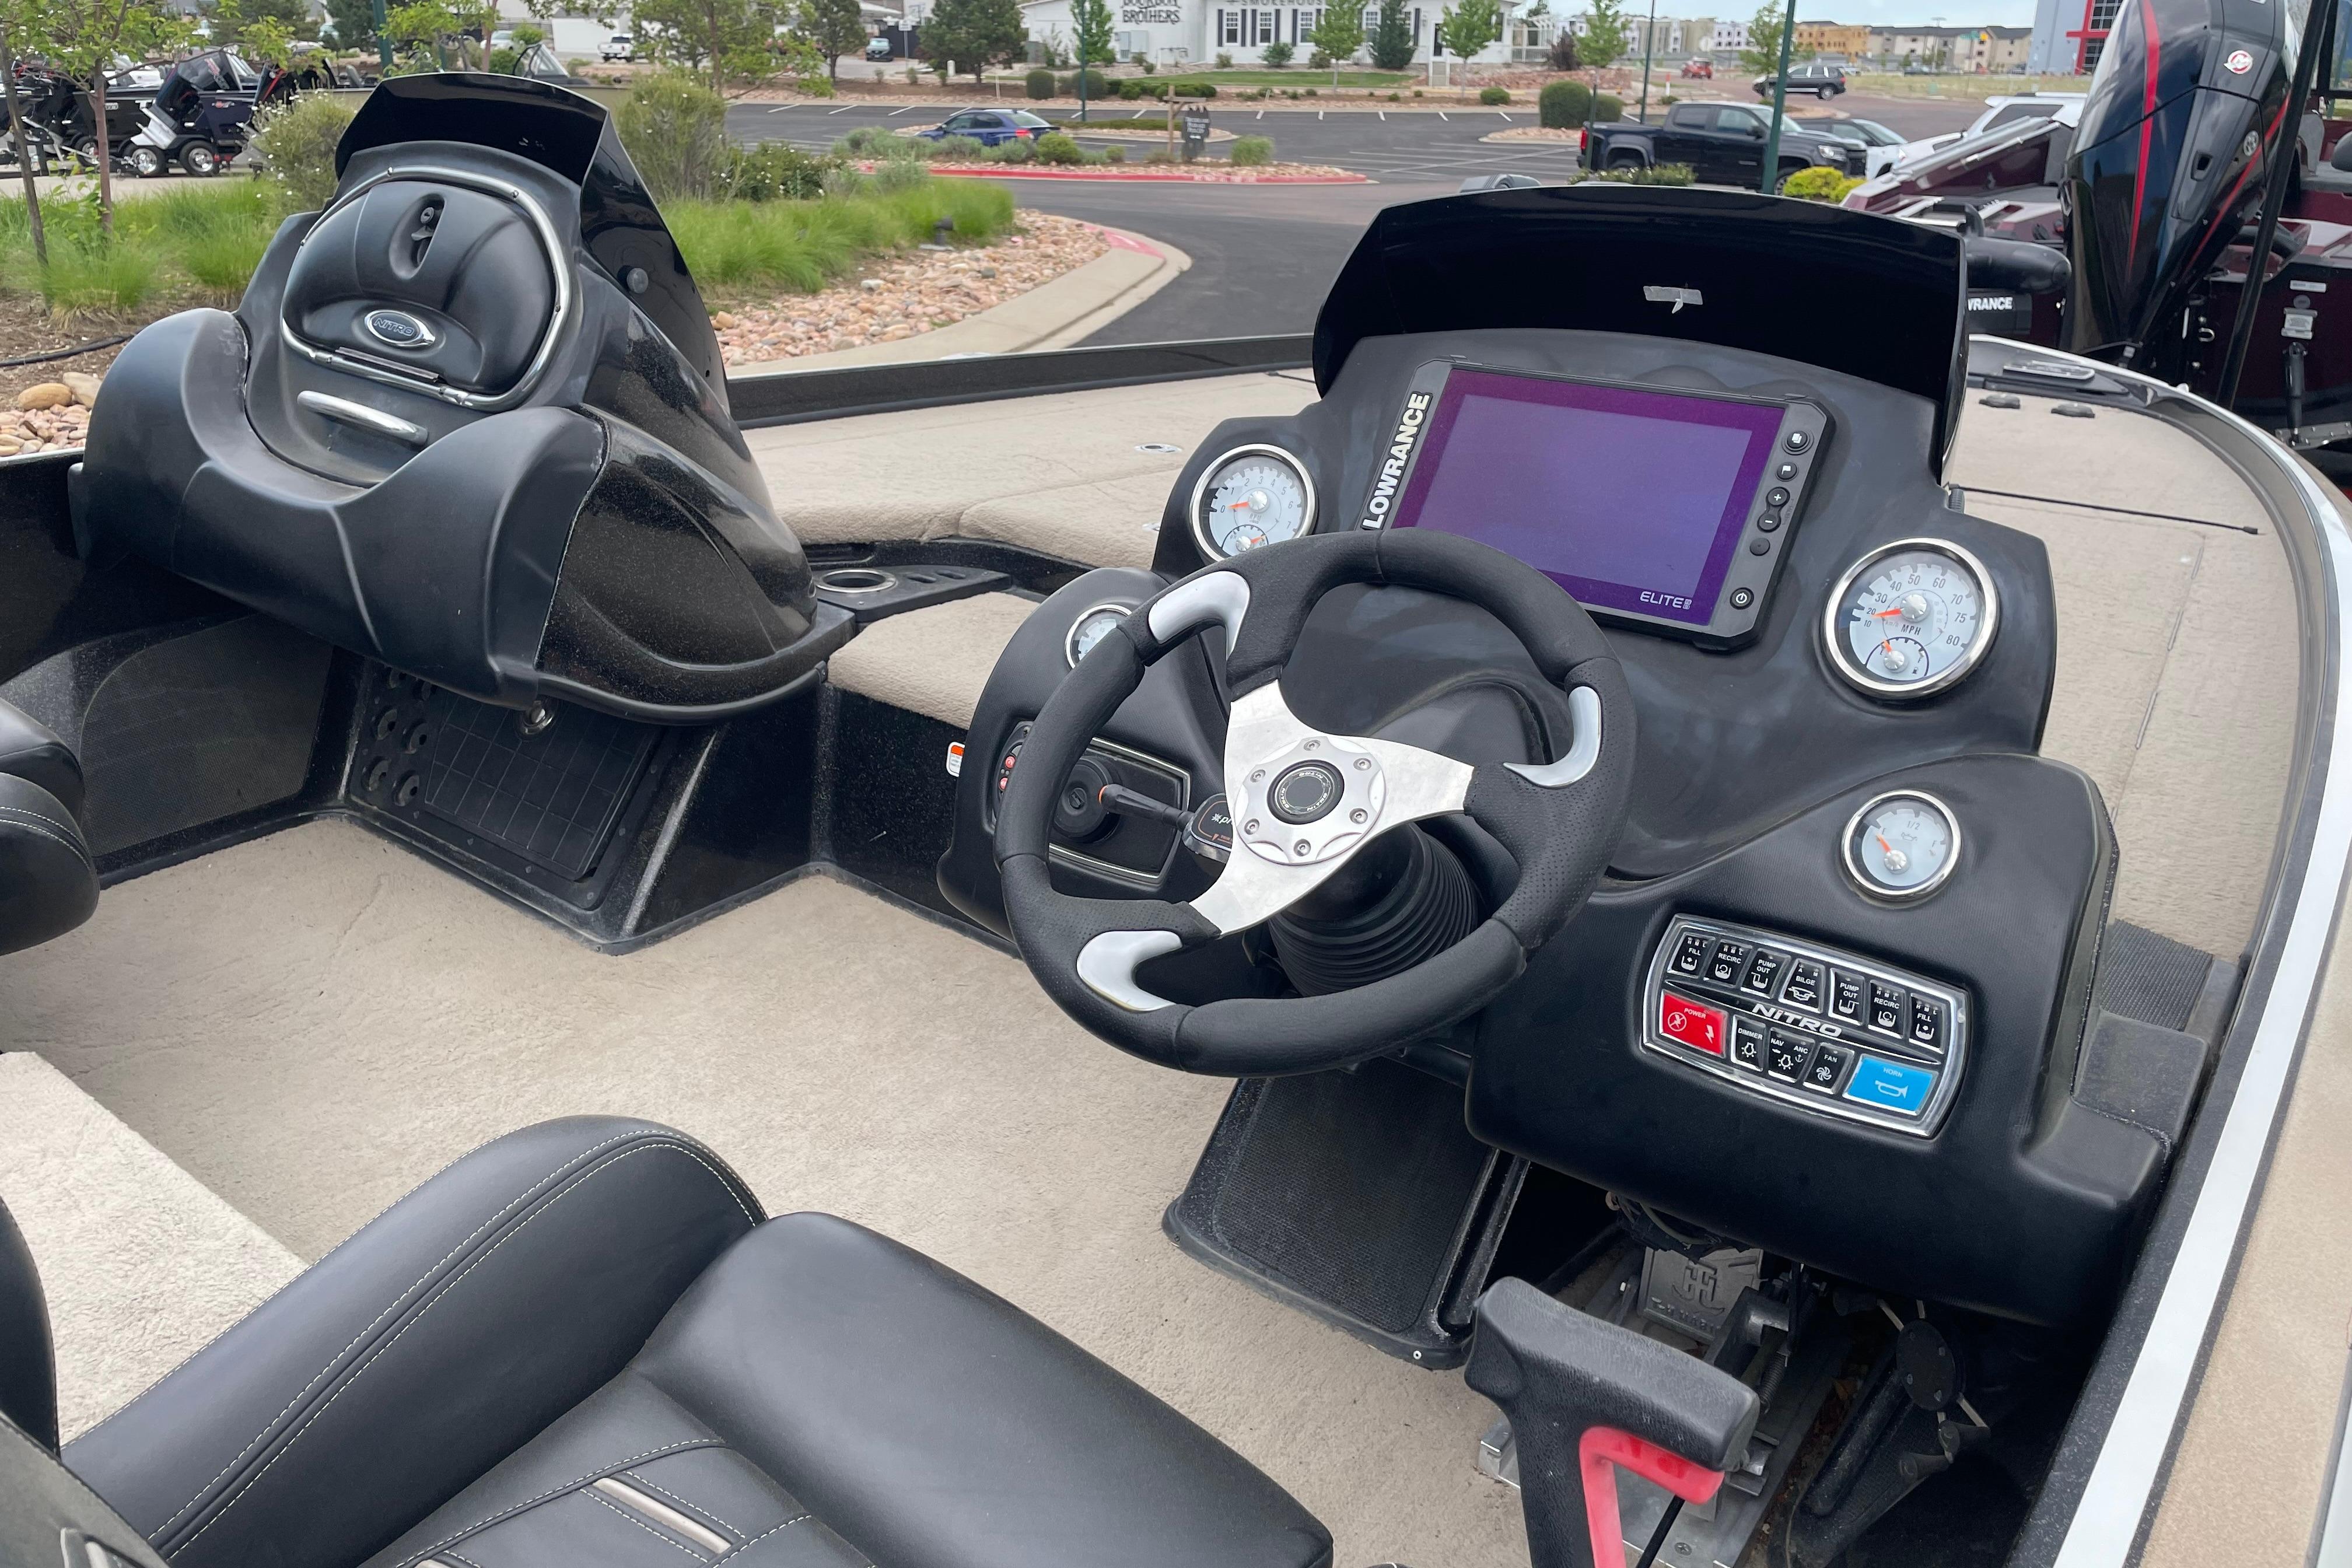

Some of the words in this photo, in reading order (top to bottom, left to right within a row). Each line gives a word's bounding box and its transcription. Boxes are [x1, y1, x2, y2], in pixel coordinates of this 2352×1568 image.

[1123, 10, 1180, 24] BROTHERS
[373, 318, 415, 336] NITRO
[1363, 393, 1430, 528] LOWRANCE
[1244, 478, 1250, 487] 2
[1258, 476, 1264, 484] 3
[1270, 479, 1276, 487] 4
[1231, 487, 1234, 495] 1
[1282, 487, 1287, 495] 5
[1288, 501, 1294, 509] 6
[1287, 521, 1291, 529] 7
[1908, 574, 1920, 585] 50
[1932, 578, 1945, 589] 60
[1889, 582, 1902, 592] 40
[1640, 591, 1685, 608] ELITE
[1875, 593, 1888, 603] 30
[1951, 594, 1964, 605] 70
[1954, 612, 1967, 623] 75
[1901, 624, 1922, 635] MPH
[1946, 635, 1959, 646] 80
[1906, 821, 1920, 830] 1/2
[1689, 947, 1701, 956] FILL
[1718, 953, 1742, 964] RECIRC
[1758, 959, 1776, 968] PUMP
[1796, 975, 1816, 986] BILGE
[1840, 982, 1860, 992] PUMP
[1843, 991, 1858, 999] OUT
[1874, 997, 1900, 1009] RECIRC
[1684, 1007, 1706, 1019] POWER
[1917, 1013, 1932, 1022] FILL
[1738, 1028, 1763, 1040] DIMMER
[1770, 1038, 1784, 1046] NAV
[1794, 1045, 1808, 1054] ANC
[1824, 1054, 1838, 1063] FAN
[1883, 1067, 1903, 1078] HORN
